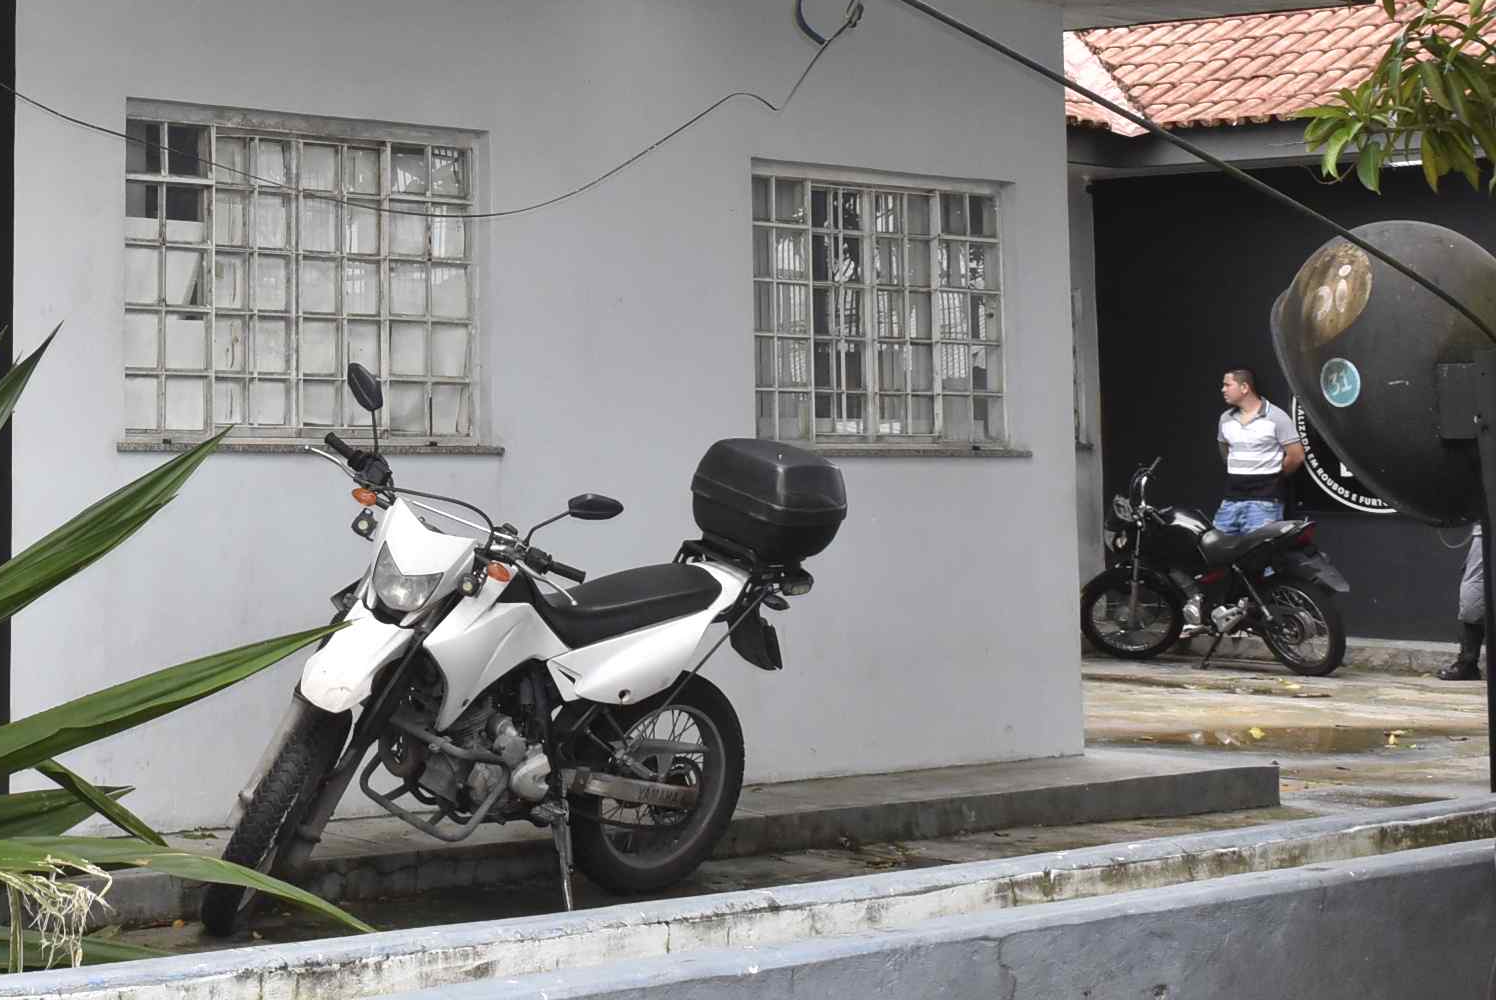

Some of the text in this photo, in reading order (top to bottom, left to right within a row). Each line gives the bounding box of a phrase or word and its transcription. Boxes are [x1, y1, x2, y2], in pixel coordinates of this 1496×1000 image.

[1297, 404, 1388, 507] ALIZADA EM ROUBOS E FURT
